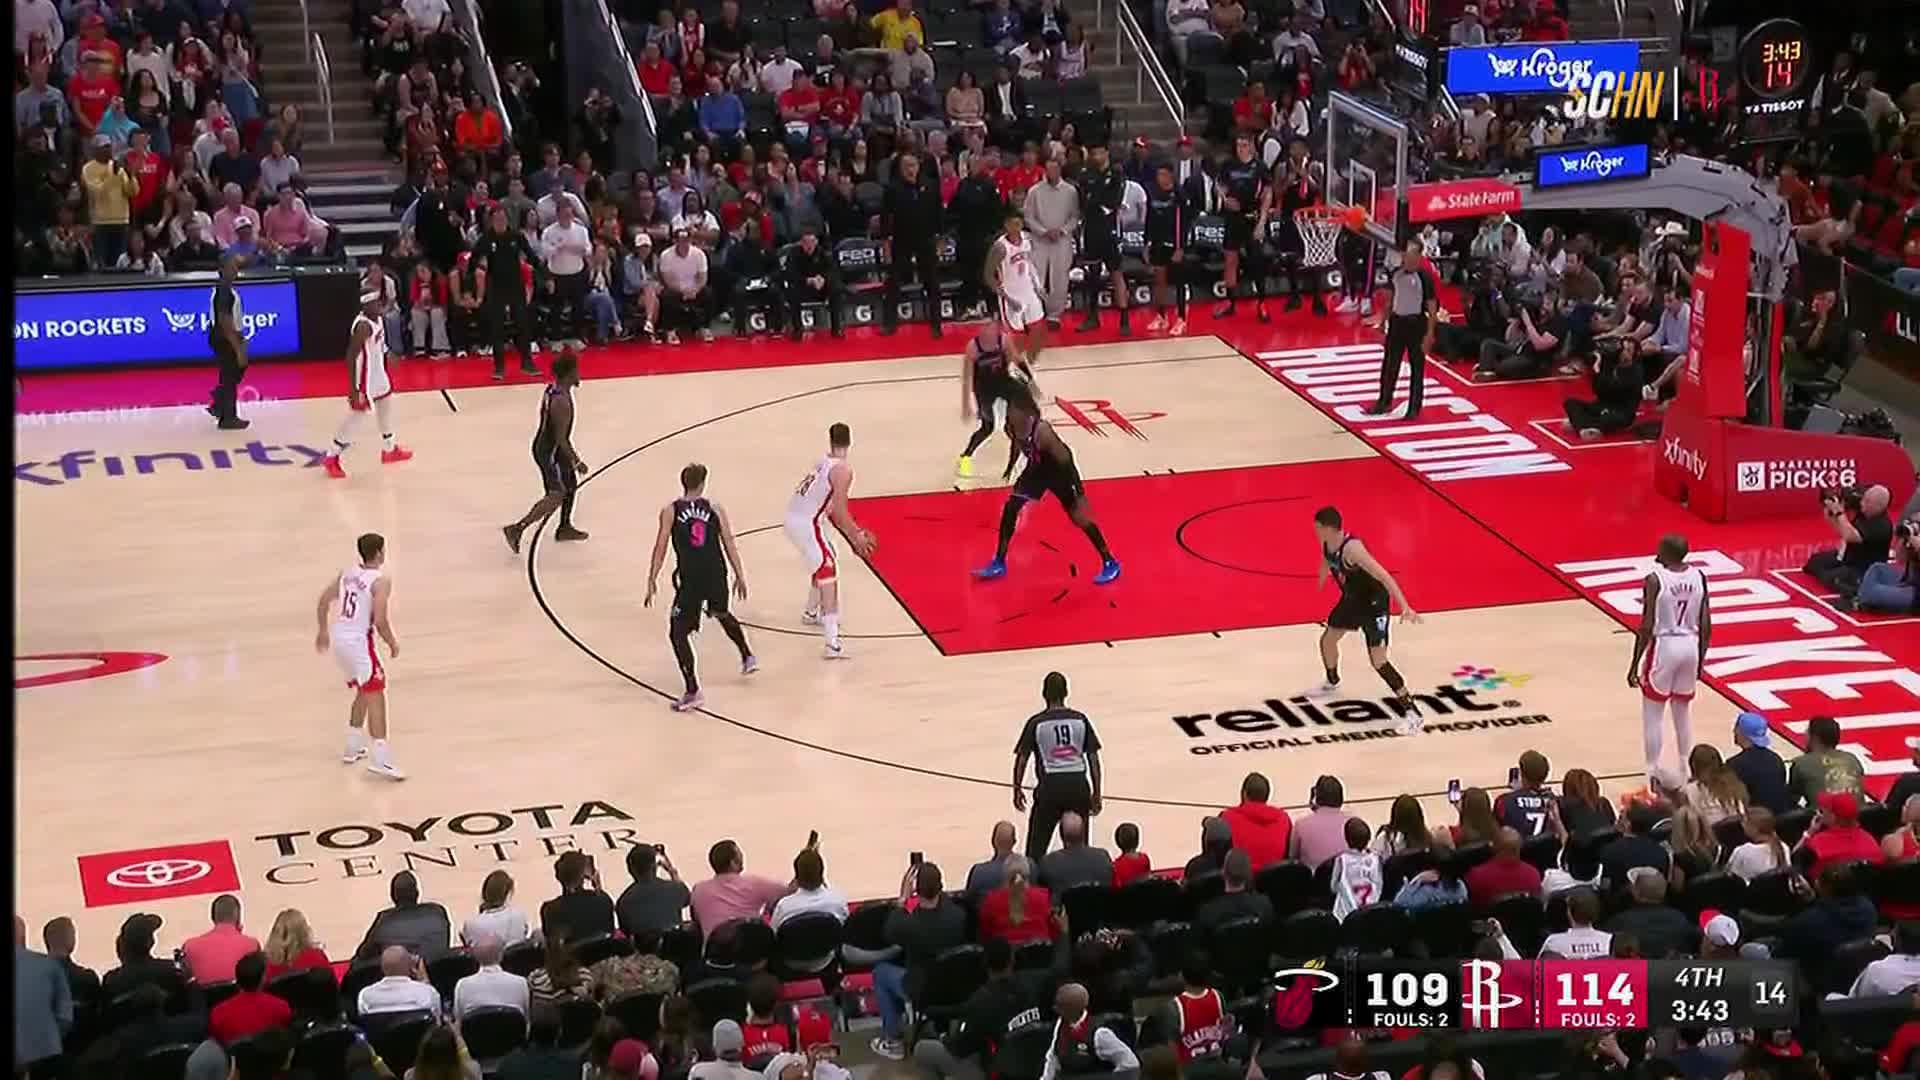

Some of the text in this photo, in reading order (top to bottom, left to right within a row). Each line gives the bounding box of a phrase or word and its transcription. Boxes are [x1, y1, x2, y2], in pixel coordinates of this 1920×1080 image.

[1762, 41, 1801, 63] 3:43
[1521, 47, 1593, 88] Kroger
[1767, 61, 1792, 88] 14
[1761, 100, 1805, 114] TISSOT
[1580, 151, 1624, 176] Kroger
[46, 316, 146, 338] ROCKETS
[1255, 344, 1573, 482] HOUSTON
[1664, 437, 1708, 480] xfinity
[690, 520, 706, 546] 9
[341, 590, 358, 618] 15
[1677, 599, 1688, 627] 7
[1054, 724, 1071, 745] 19
[1190, 714, 1552, 756] OFFICIAL ENERG PROVIDER
[254, 800, 636, 857] TOYOTA
[1525, 812, 1546, 836] 7
[264, 827, 640, 885] CENTER
[1353, 883, 1373, 906] 7
